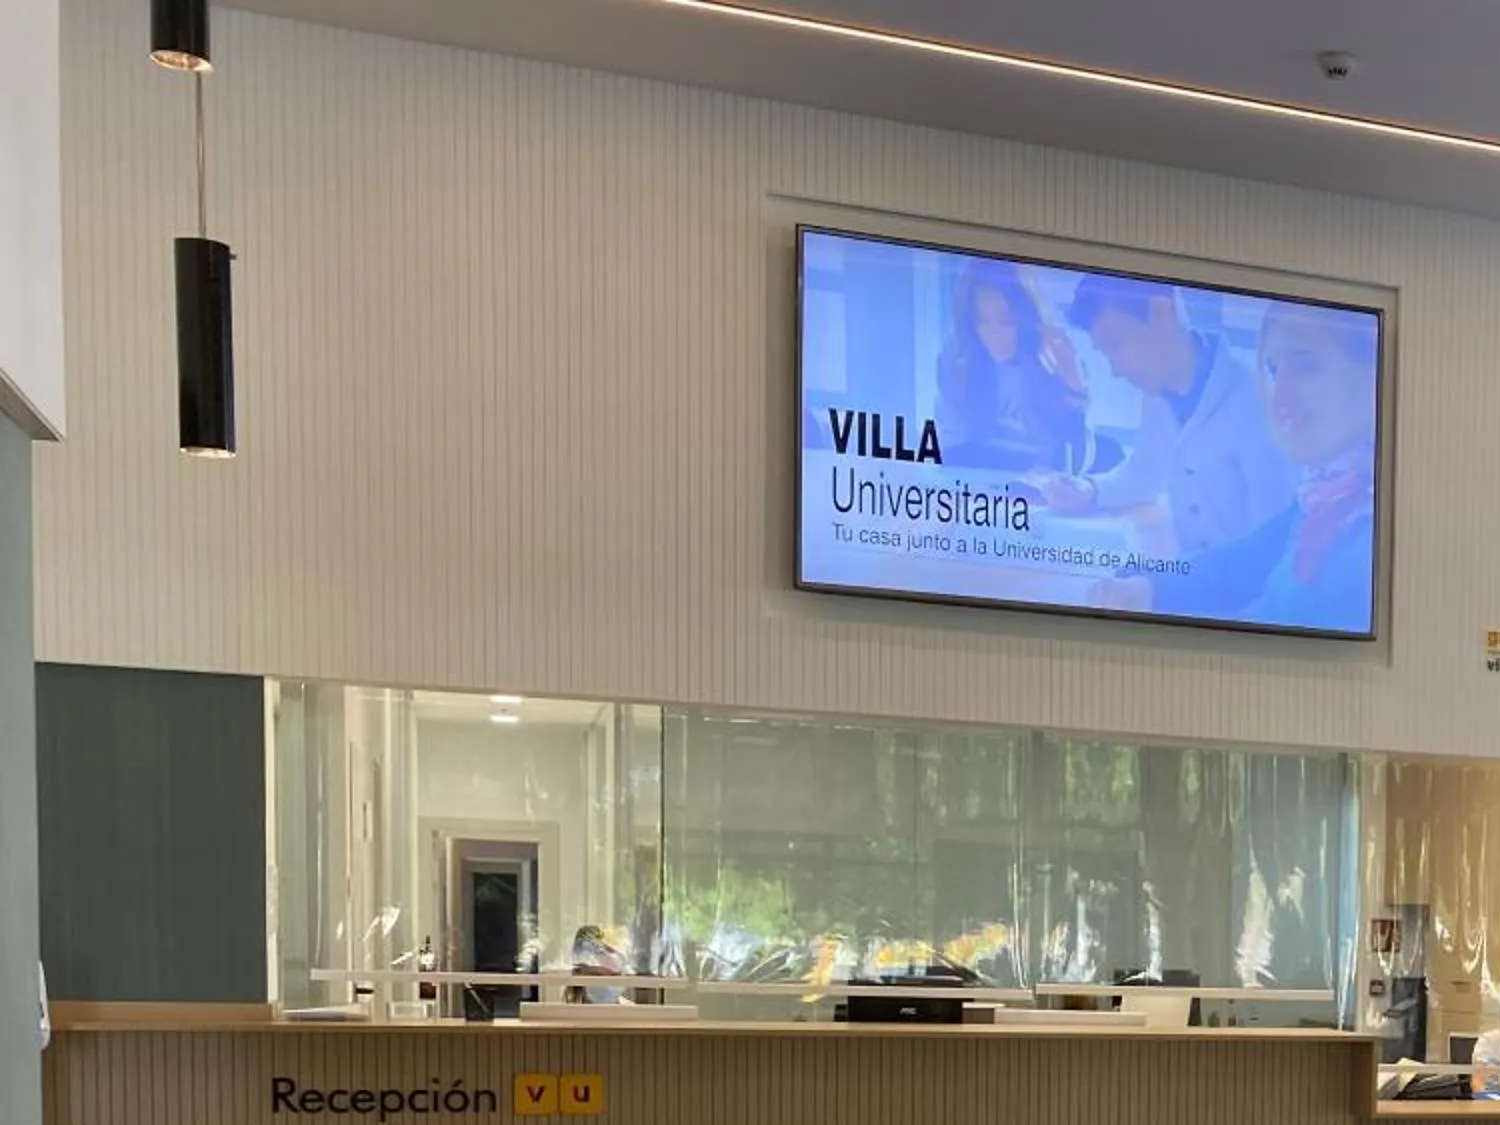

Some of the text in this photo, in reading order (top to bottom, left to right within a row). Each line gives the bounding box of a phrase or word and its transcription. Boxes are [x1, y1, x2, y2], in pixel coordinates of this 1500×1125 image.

[829, 408, 943, 464] VILLA
[832, 466, 1030, 531] Universitaria
[832, 522, 854, 542] Tu
[859, 527, 902, 547] casa
[907, 533, 951, 552] junto
[955, 540, 968, 554] a
[973, 539, 988, 555] la
[993, 542, 1094, 566] Universidad
[1100, 550, 1121, 568] de
[271, 1076, 497, 1123] Recepción
